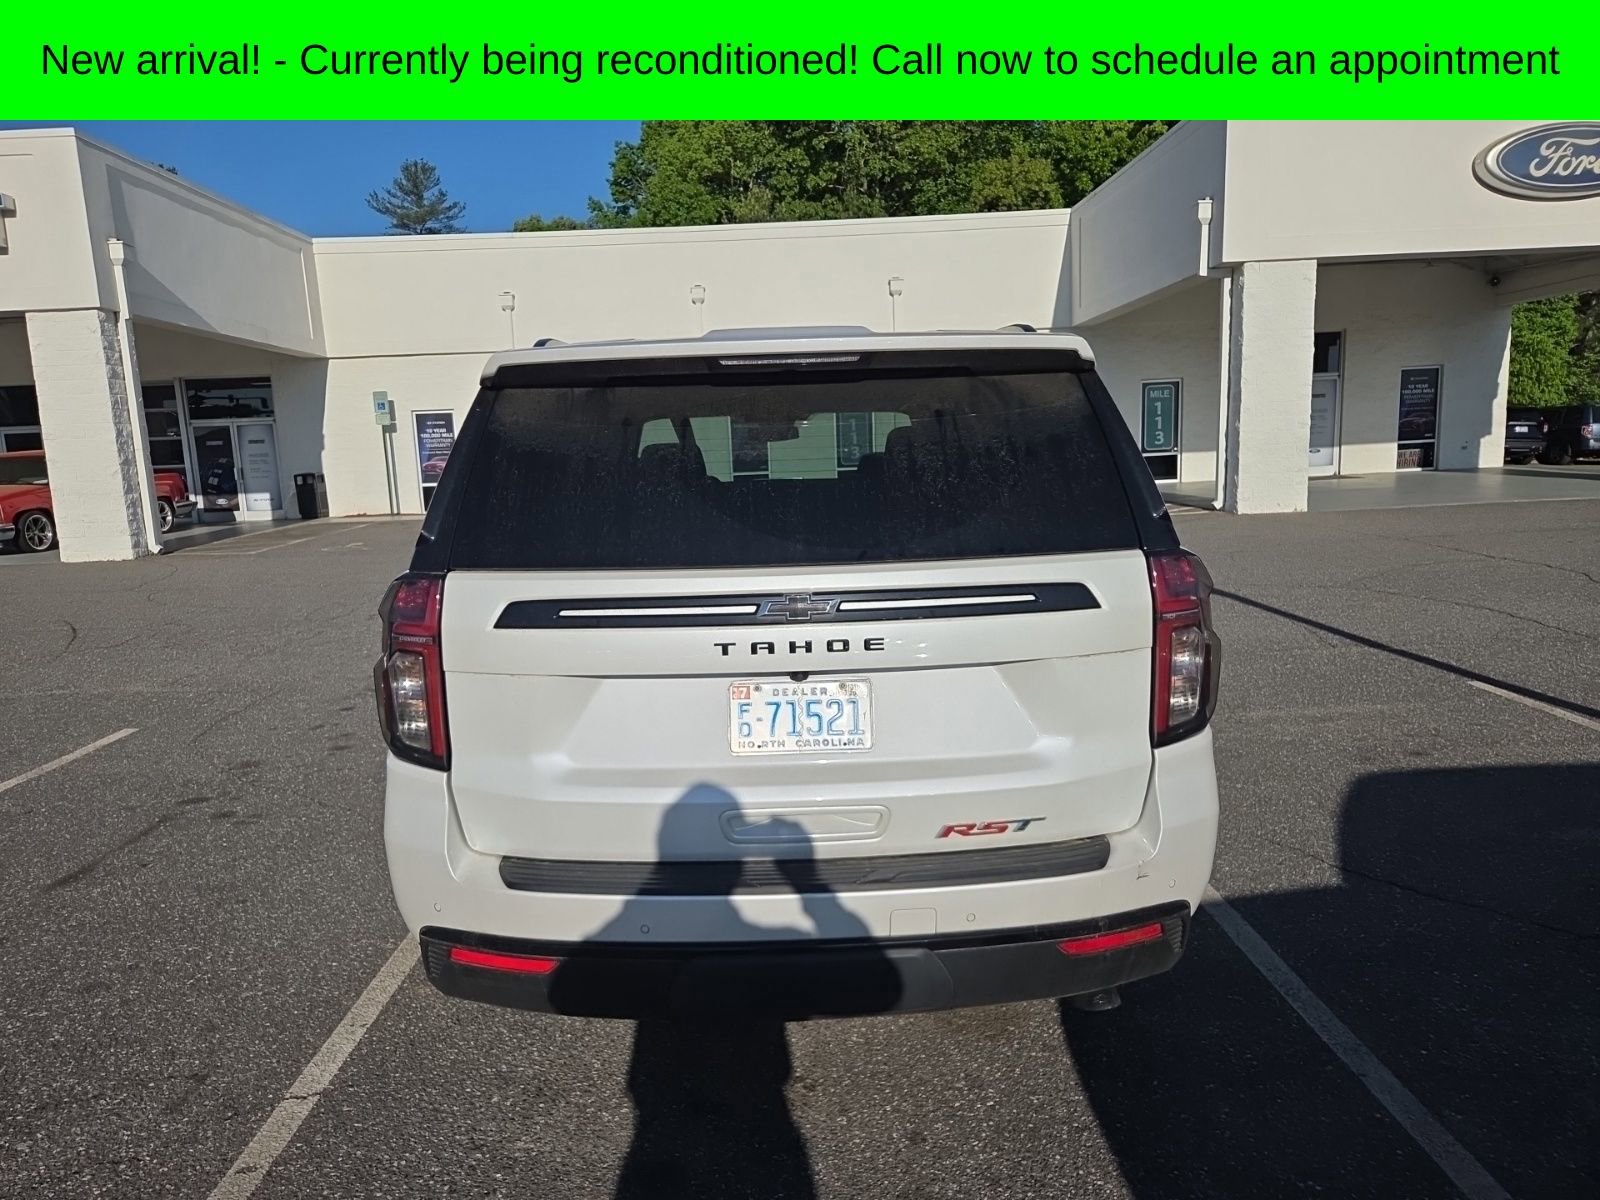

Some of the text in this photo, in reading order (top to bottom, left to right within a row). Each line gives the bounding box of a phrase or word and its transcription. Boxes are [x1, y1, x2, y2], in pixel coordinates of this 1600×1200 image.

[1150, 389, 1170, 398] MILE
[713, 637, 885, 656] TAHOE
[773, 687, 829, 697] DEALER
[738, 738, 865, 749] NORTH CAROLINA
[935, 816, 1047, 839] RST
